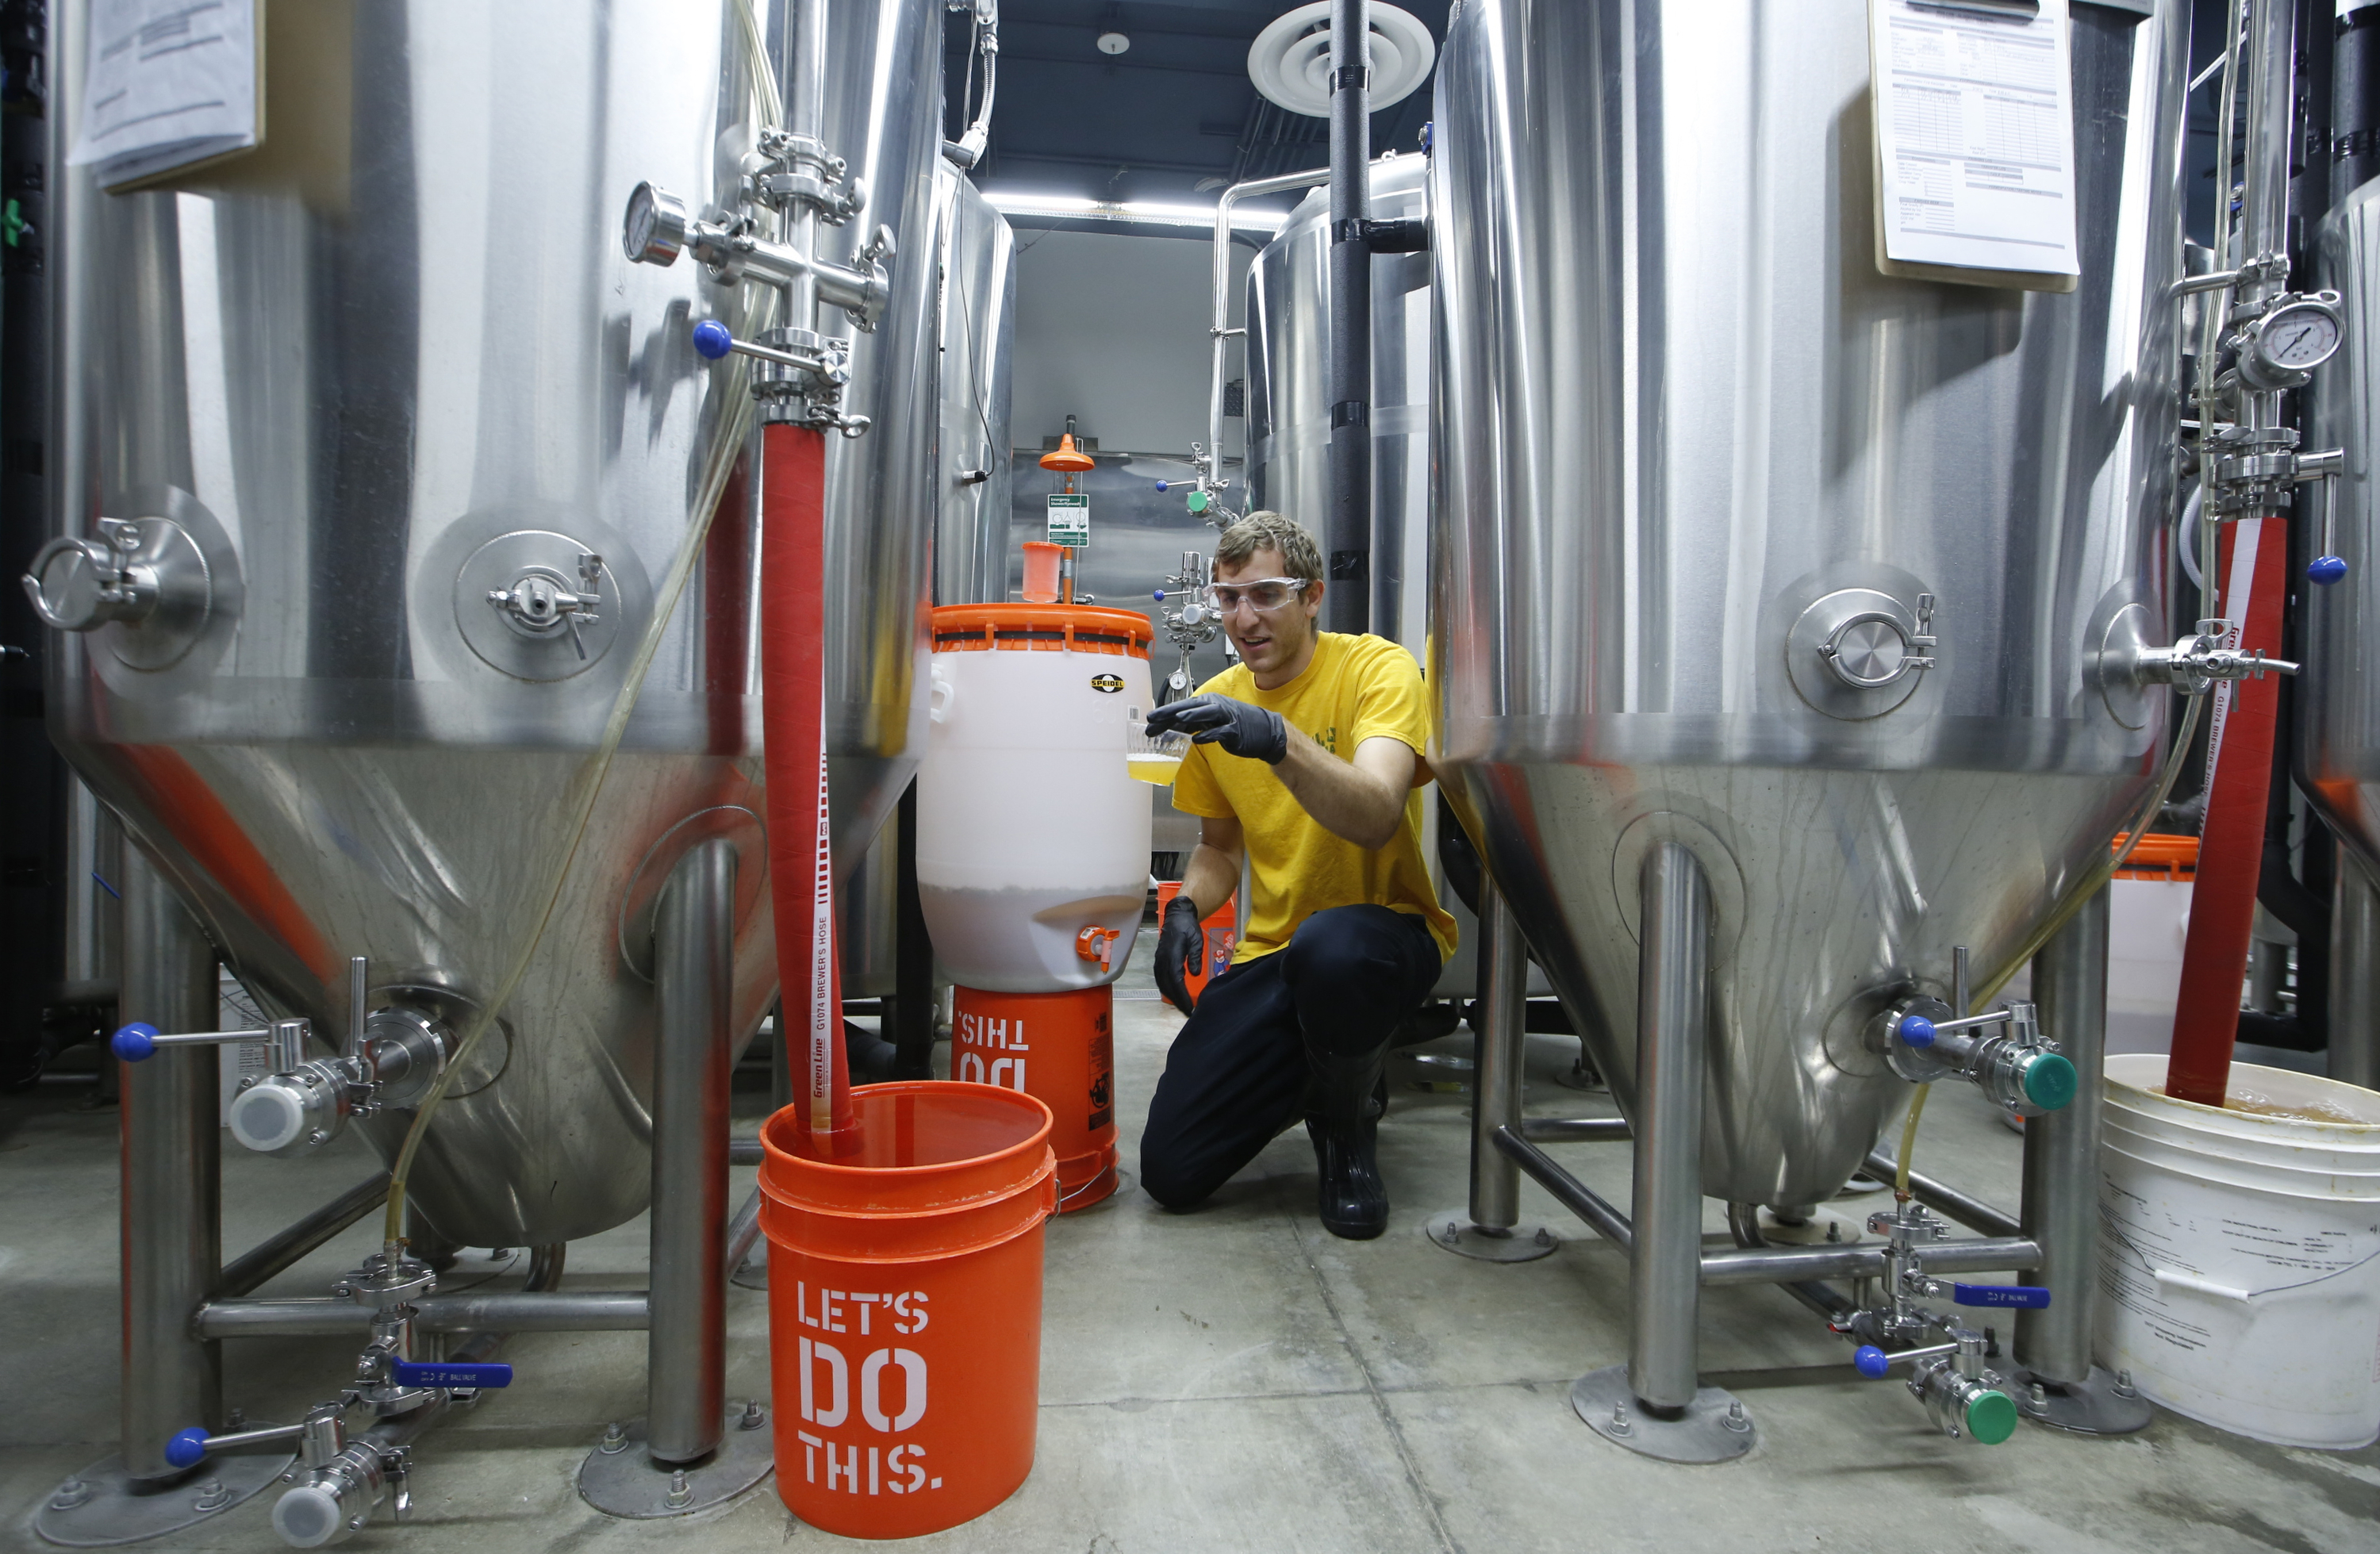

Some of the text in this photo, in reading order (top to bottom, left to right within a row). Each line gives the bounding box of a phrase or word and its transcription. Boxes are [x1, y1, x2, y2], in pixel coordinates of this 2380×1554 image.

[2214, 696, 2225, 723] G1074
[814, 916, 827, 1099] Green Line G1074 BREWER'S HOSE
[958, 1011, 1029, 1051] THIS.
[797, 1280, 929, 1335] LET'S
[799, 1335, 927, 1433] DO
[797, 1429, 942, 1495] THIS.
